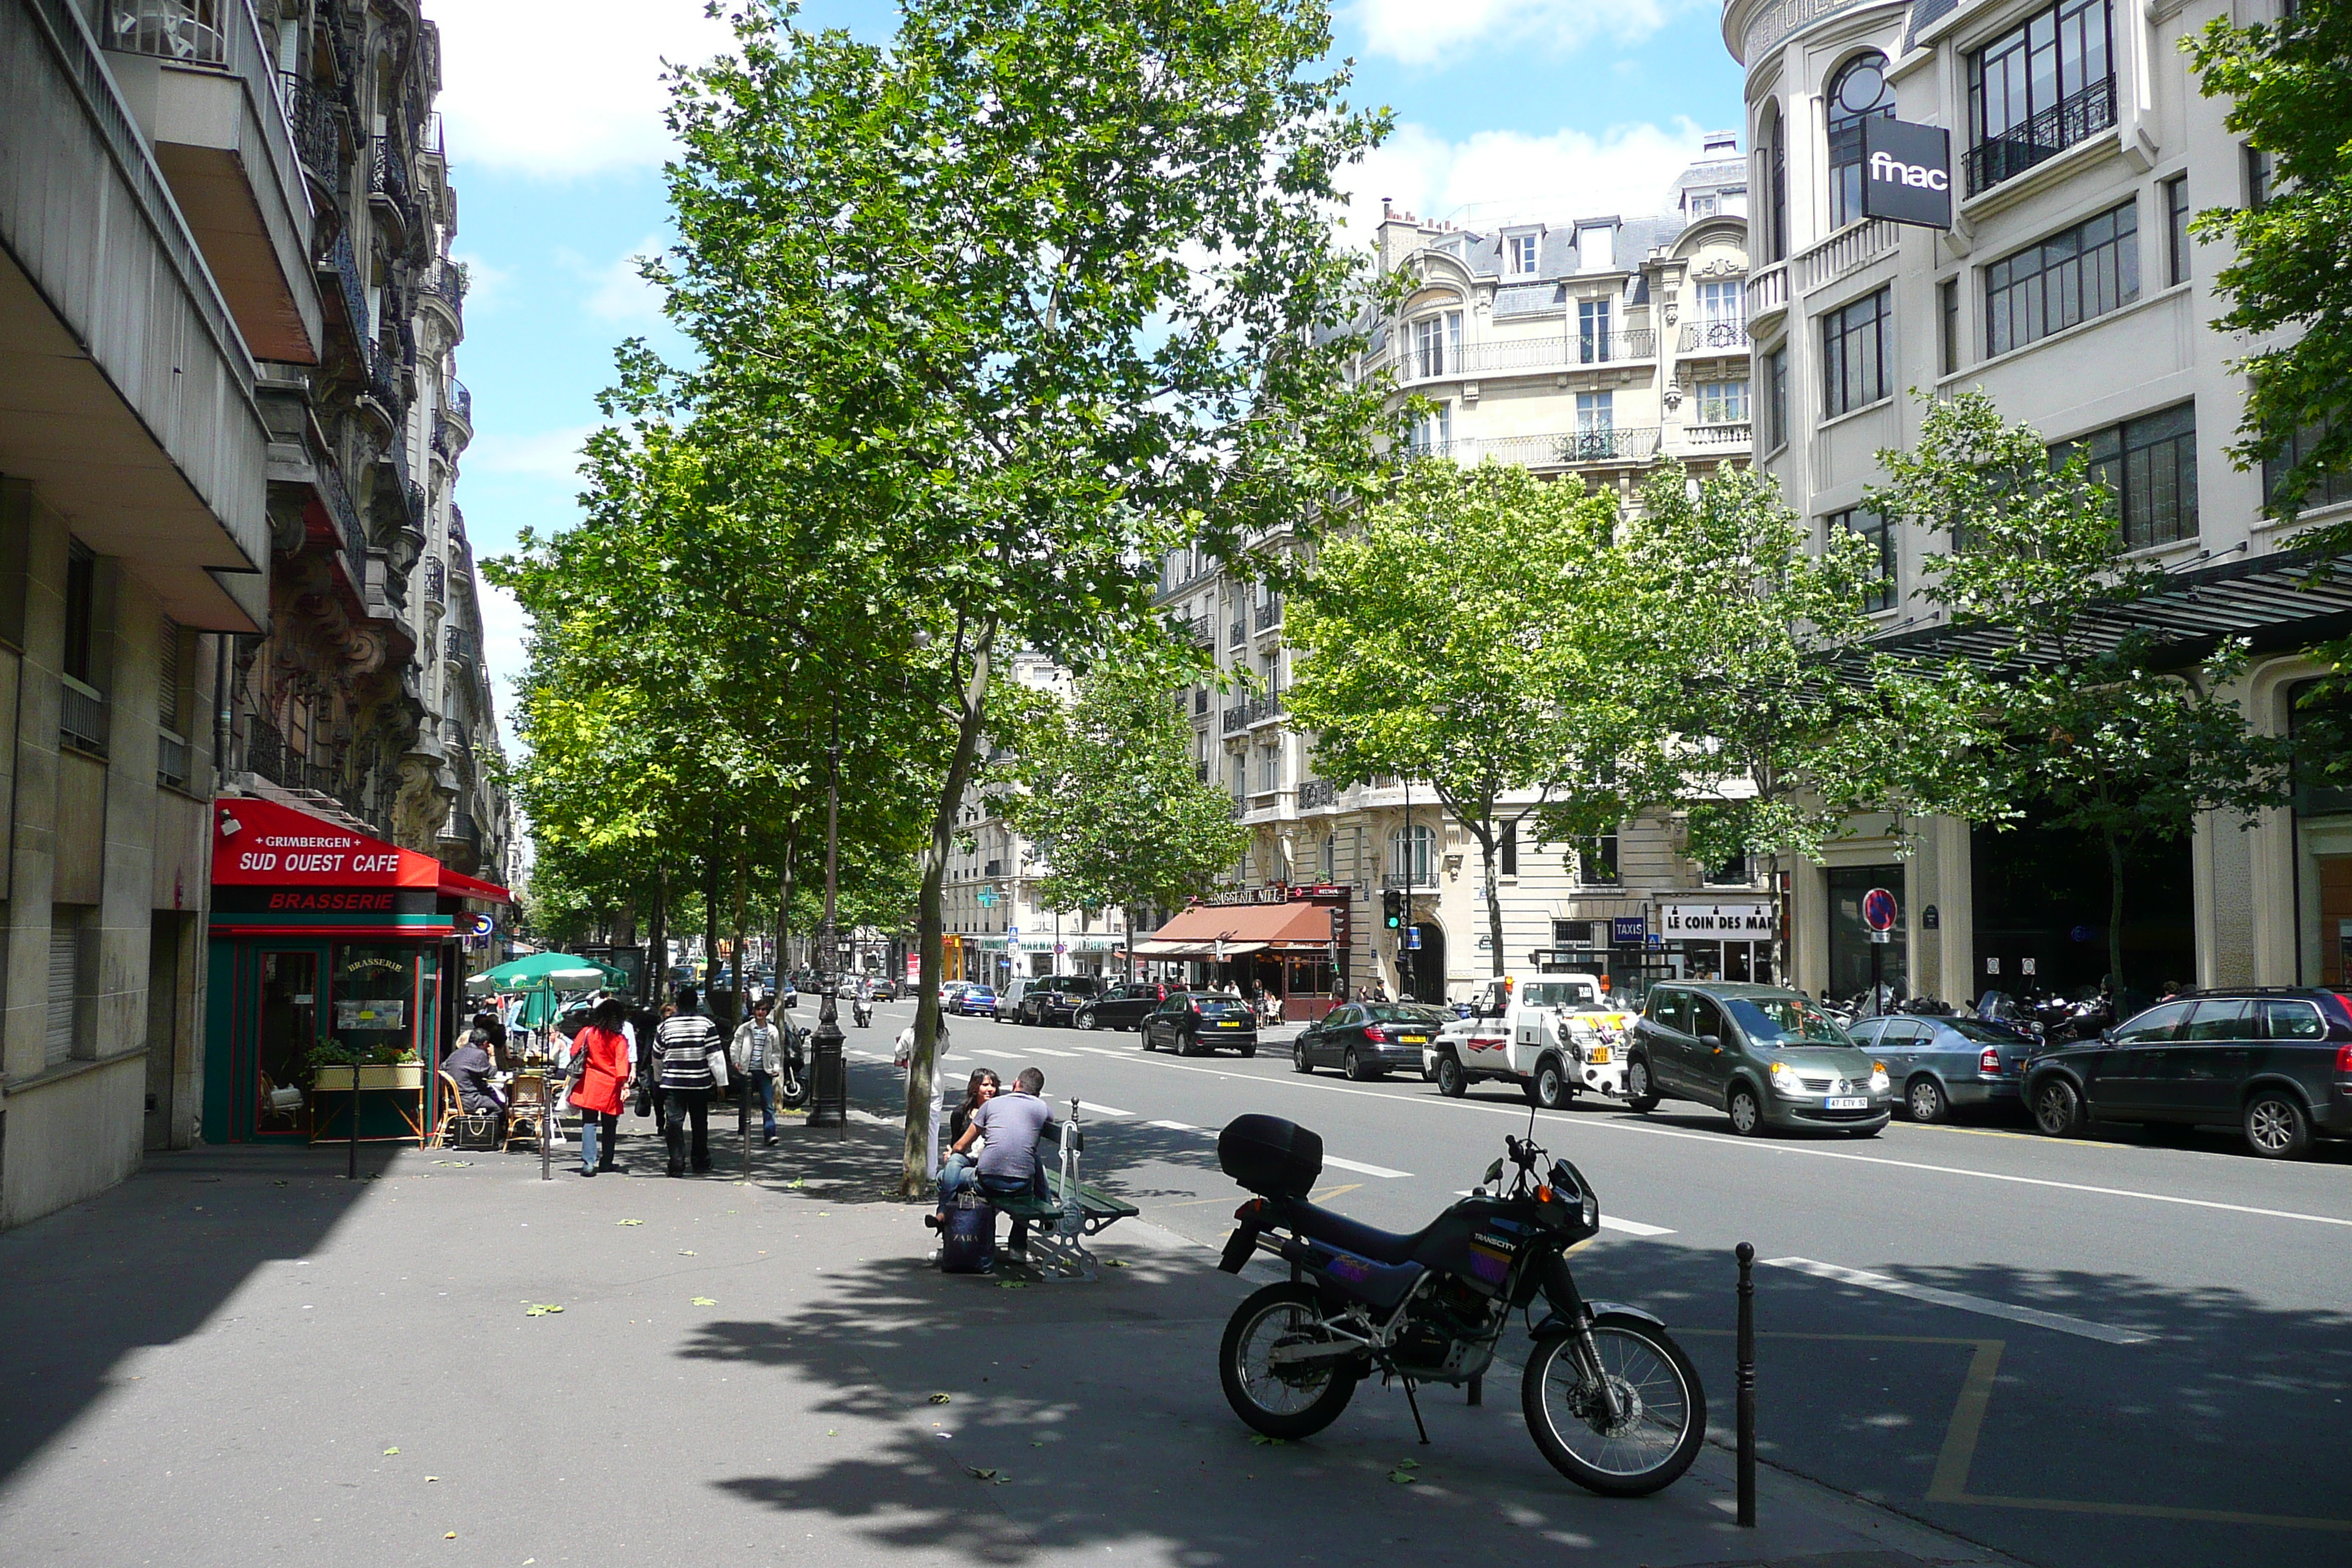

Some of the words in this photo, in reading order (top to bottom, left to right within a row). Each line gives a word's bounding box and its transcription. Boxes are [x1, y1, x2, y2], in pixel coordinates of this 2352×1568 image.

[1869, 151, 1948, 191] fnac
[265, 836, 350, 848] GRIMBERGEN
[240, 853, 276, 870] SUD
[284, 854, 344, 871] OUEST
[353, 855, 399, 872] CAFE
[268, 893, 394, 910] BRASSERIE
[1616, 924, 1643, 935] TAXIS
[1668, 916, 1680, 929] LE
[1685, 916, 1714, 929] COIN
[1719, 916, 1741, 929] DES
[1017, 941, 1068, 951] HARMAE
[347, 958, 402, 973] BRASSERIE
[953, 1234, 979, 1242] ZARA
[1474, 1232, 1517, 1251] TRANSCITY
